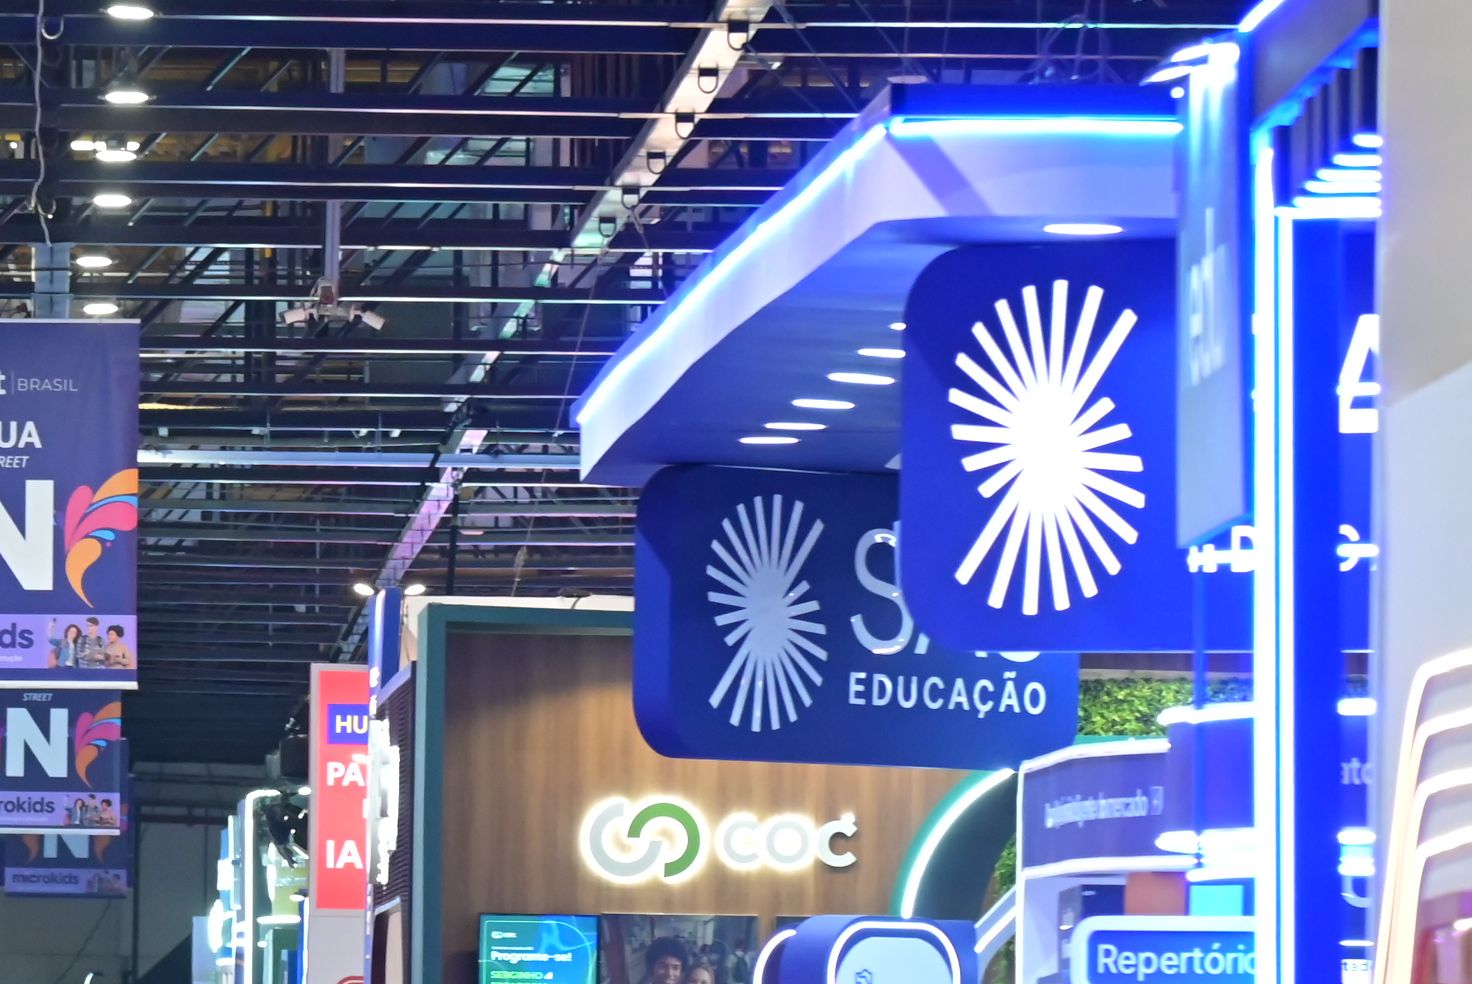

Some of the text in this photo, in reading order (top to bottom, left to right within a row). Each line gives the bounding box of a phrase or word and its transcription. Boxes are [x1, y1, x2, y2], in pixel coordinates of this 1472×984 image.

[17, 378, 78, 392] BRASIL
[23, 693, 53, 702] STREET
[848, 670, 1047, 719] EDUCAÇÃO
[6, 707, 69, 778] N
[12, 871, 80, 886] microkids
